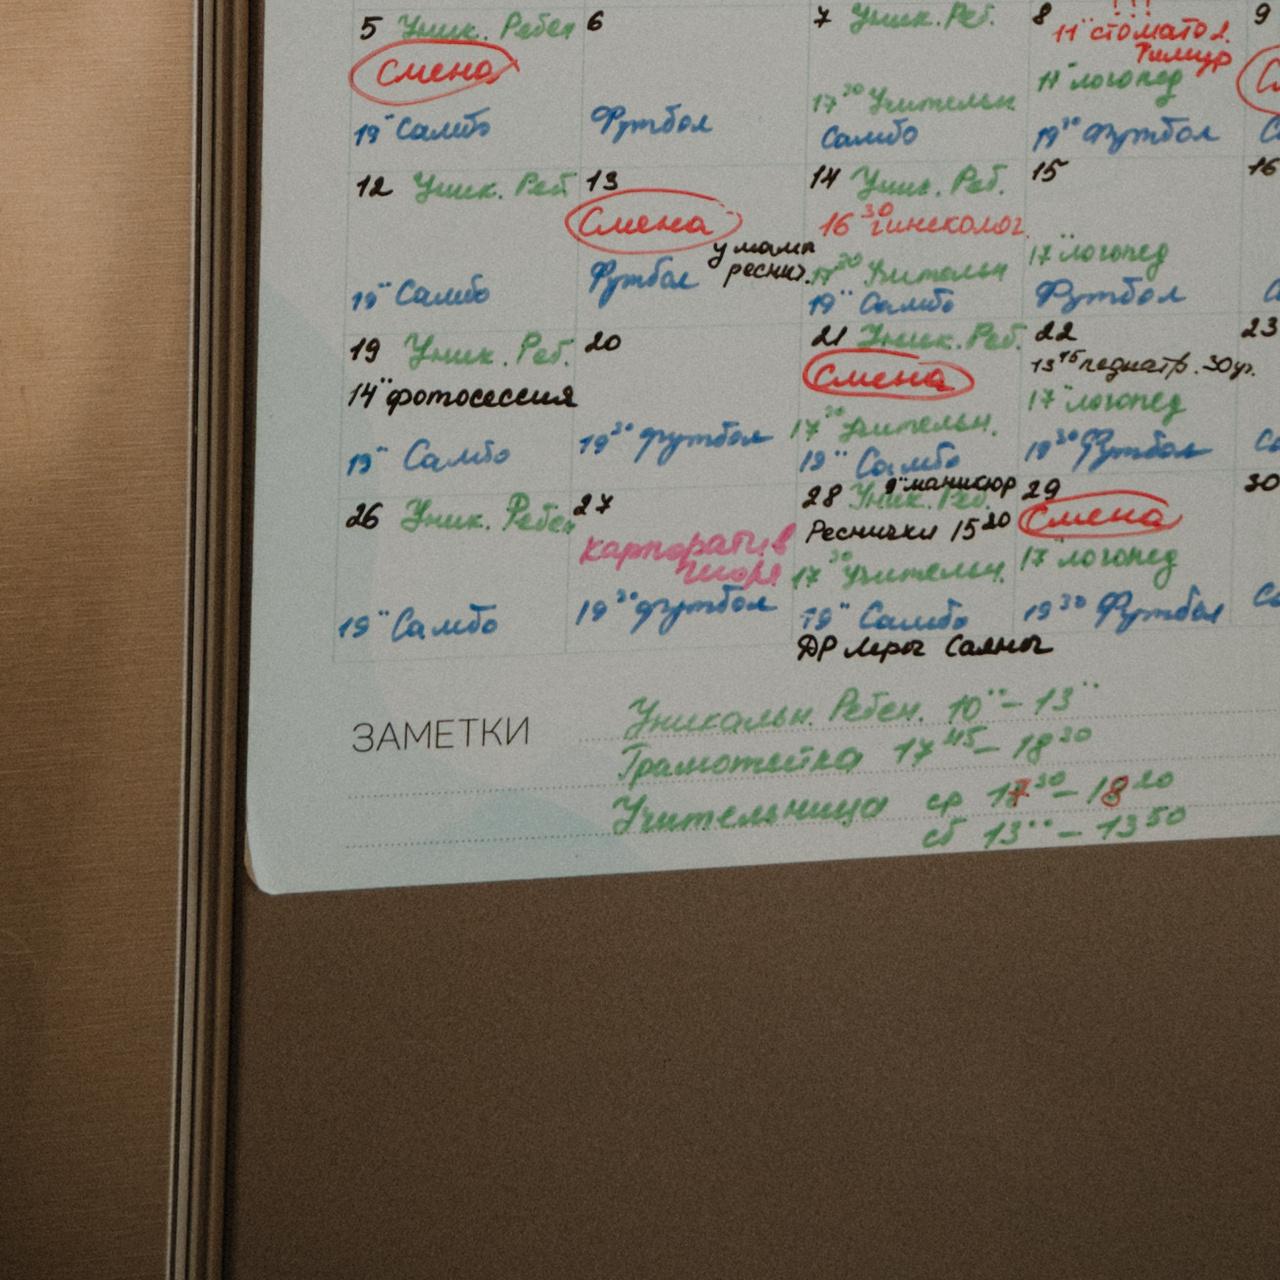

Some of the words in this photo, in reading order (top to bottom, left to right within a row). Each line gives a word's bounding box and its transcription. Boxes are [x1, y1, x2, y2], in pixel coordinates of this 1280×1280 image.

[587, 10, 604, 32] 6
[813, 6, 832, 28] 7
[1033, 3, 1052, 25] 8
[1254, 3, 1271, 25] 9
[361, 17, 383, 40] 5
[376, 59, 500, 87] Смена
[810, 165, 842, 190] 14
[1032, 160, 1069, 182] 15
[1249, 156, 1280, 178] 16
[356, 175, 393, 198] 12
[586, 171, 620, 193] 13
[578, 206, 714, 237] Смена
[812, 326, 848, 347] 21
[1035, 321, 1078, 342] 22
[1241, 317, 1279, 339] 23
[351, 338, 381, 362] 19
[584, 332, 622, 353] 20
[811, 364, 956, 392] Смена
[386, 385, 578, 416] фотосессия
[1021, 478, 1061, 501] 29
[1244, 473, 1280, 493] 30
[573, 493, 613, 516] 27
[802, 484, 842, 509] 28
[346, 503, 383, 529] 26
[1026, 504, 1183, 528] Смена
[352, 716, 531, 753] ЗАМЕТКИ
